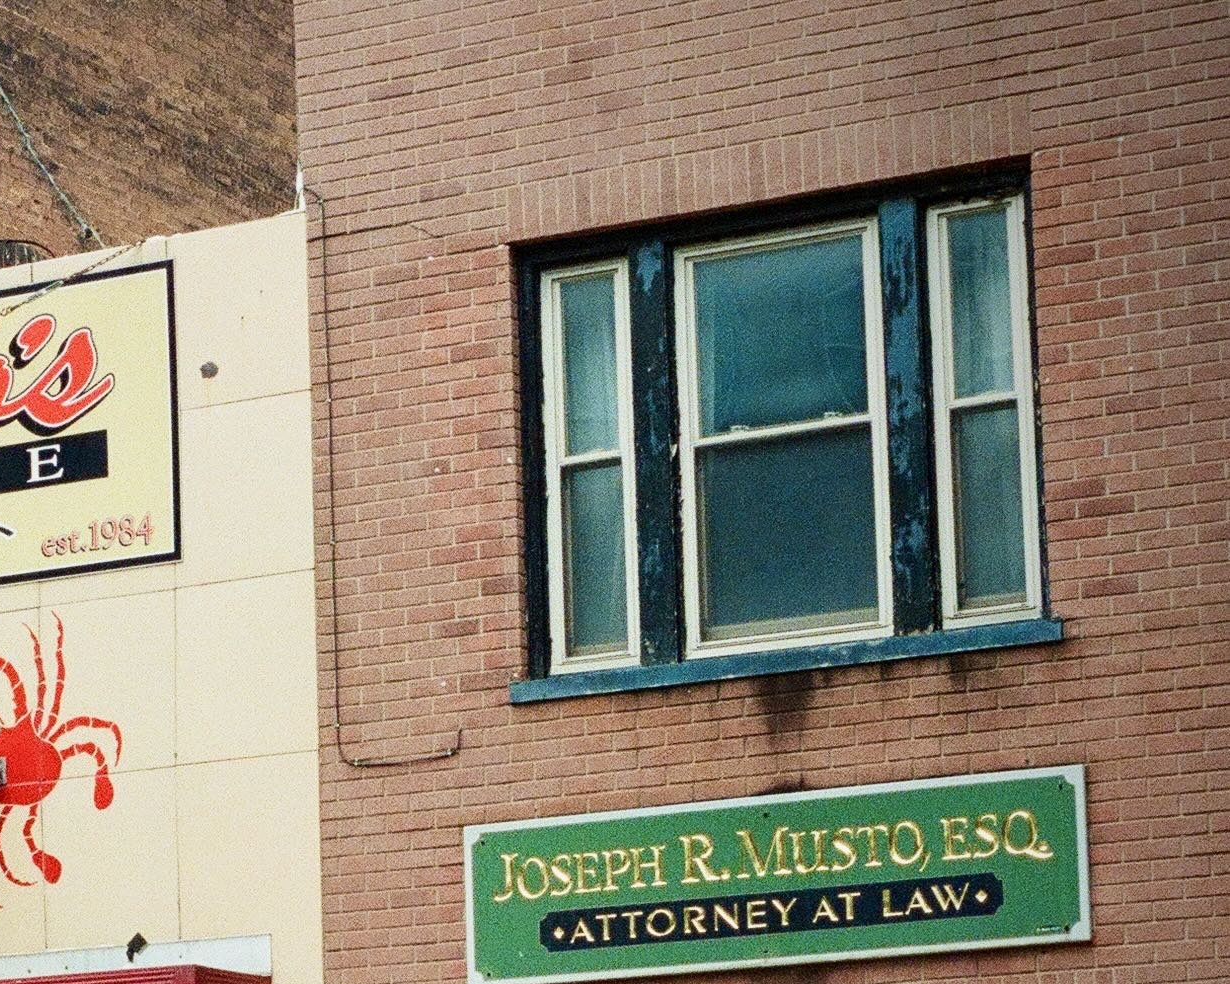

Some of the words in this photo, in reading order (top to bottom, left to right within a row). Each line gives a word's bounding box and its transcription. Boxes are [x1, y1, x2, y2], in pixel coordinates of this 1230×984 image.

[492, 843, 667, 902] JOSEPH
[678, 832, 730, 885] R.
[735, 820, 931, 880] MUSTO,
[940, 808, 1055, 862] ESQ.
[570, 897, 797, 945] ATTORNEY
[813, 891, 862, 924] AT
[882, 883, 971, 917] LAW
